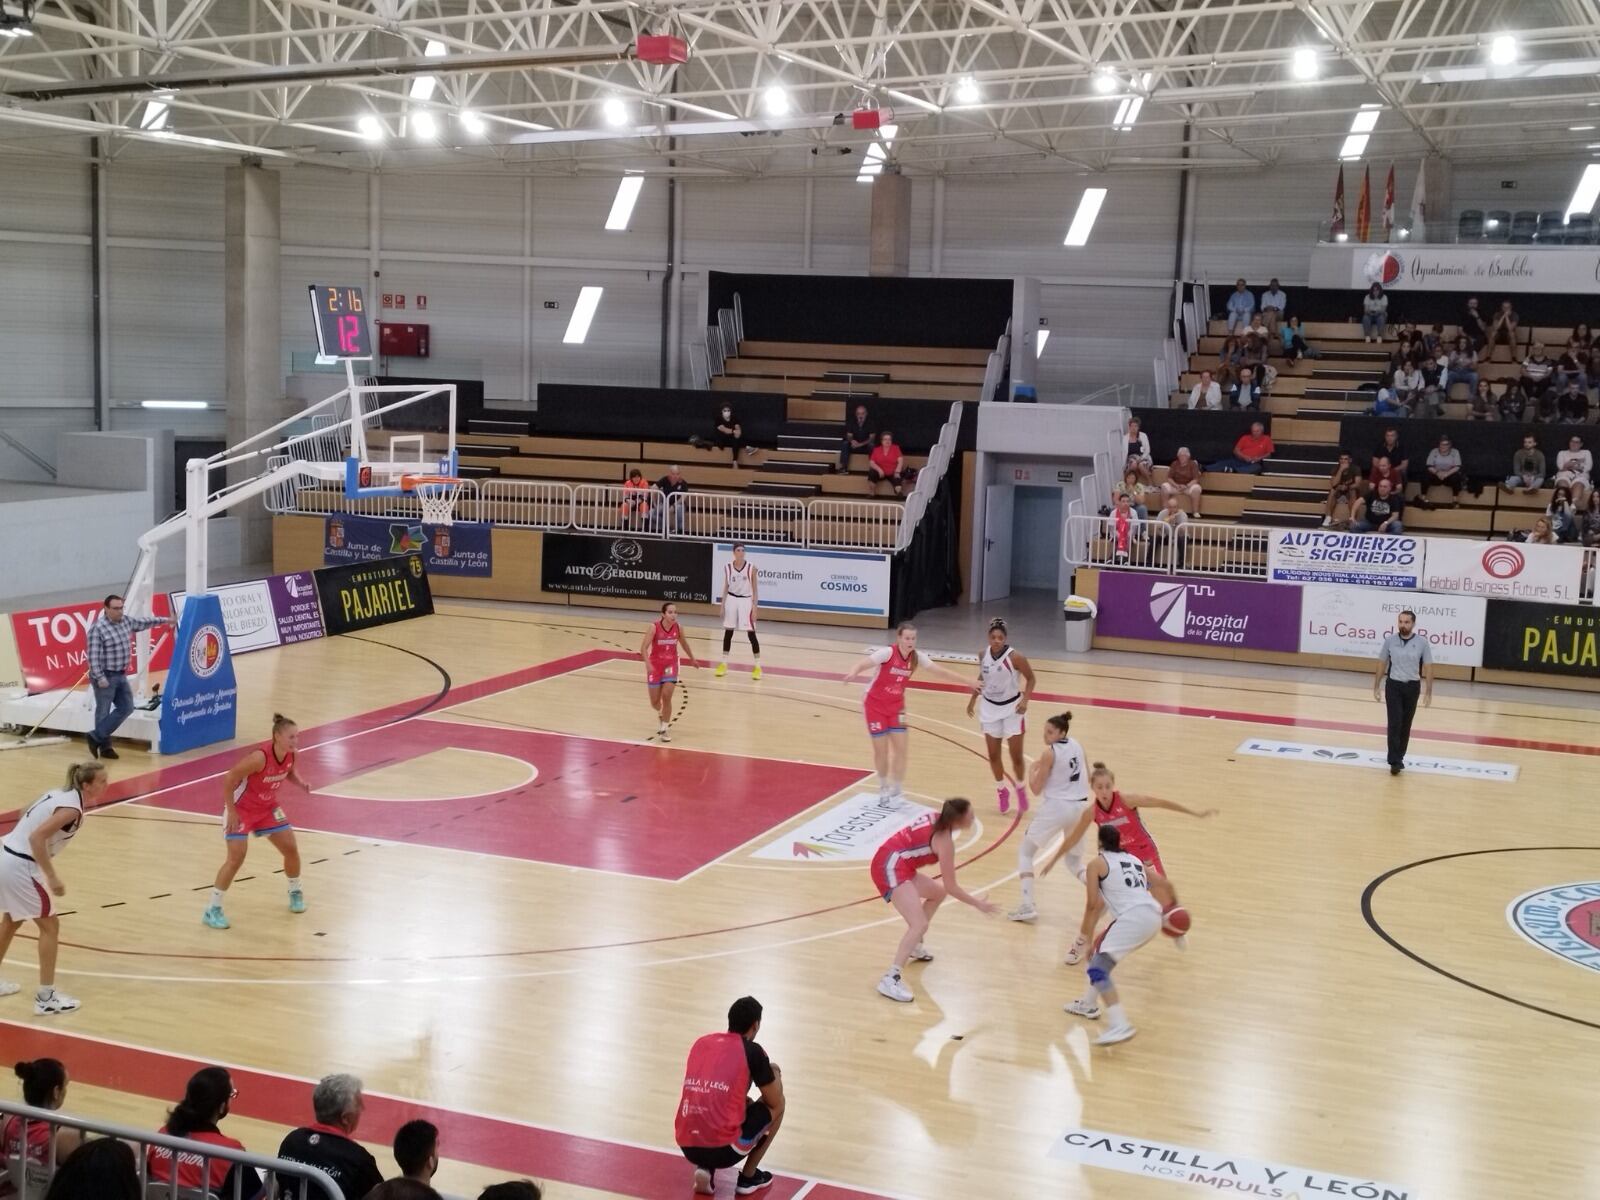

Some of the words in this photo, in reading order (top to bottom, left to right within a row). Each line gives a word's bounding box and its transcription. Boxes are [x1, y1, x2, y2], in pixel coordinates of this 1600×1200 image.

[328, 288, 362, 312] 2:16
[338, 315, 360, 352] 12
[347, 543, 369, 553] Junta
[370, 544, 382, 553] de
[1279, 532, 1417, 552] AUTOBIERZO
[325, 547, 353, 558] Castilla
[354, 550, 360, 560] y
[361, 549, 382, 561] León
[452, 551, 475, 560] Junta
[477, 551, 488, 560] de
[1309, 548, 1415, 565] SIGFREDO
[429, 556, 459, 567] Castilla
[460, 559, 467, 569] y
[468, 557, 488, 568] León
[756, 569, 803, 581] otorantim
[548, 582, 647, 596] www.autobergidum.com
[663, 590, 677, 599] 987
[694, 592, 708, 601] 226
[820, 581, 868, 593] COSMOS
[1429, 576, 1460, 591] Global
[1463, 577, 1510, 594] Business
[341, 579, 415, 623] PAJARIEL
[1381, 603, 1457, 617] RESTAURANTE
[28, 608, 120, 647] TOY
[241, 616, 268, 630] BIERZO
[278, 615, 294, 625] SALUD
[293, 621, 321, 632] IMPORTANTE
[1186, 611, 1249, 630] hospital
[1554, 615, 1600, 627] EMBU
[1204, 628, 1245, 643] reina
[1309, 620, 1328, 635] La
[1334, 622, 1376, 639] Casa
[46, 655, 64, 670] N.
[1069, 757, 1081, 782] 2
[1063, 1132, 1240, 1175] CASTILLA
[1263, 1167, 1289, 1185] Y
[1304, 1174, 1408, 1200] LEÓN
[1143, 1164, 1186, 1179] NOS
[1188, 1173, 1302, 1200] IMPULSA
